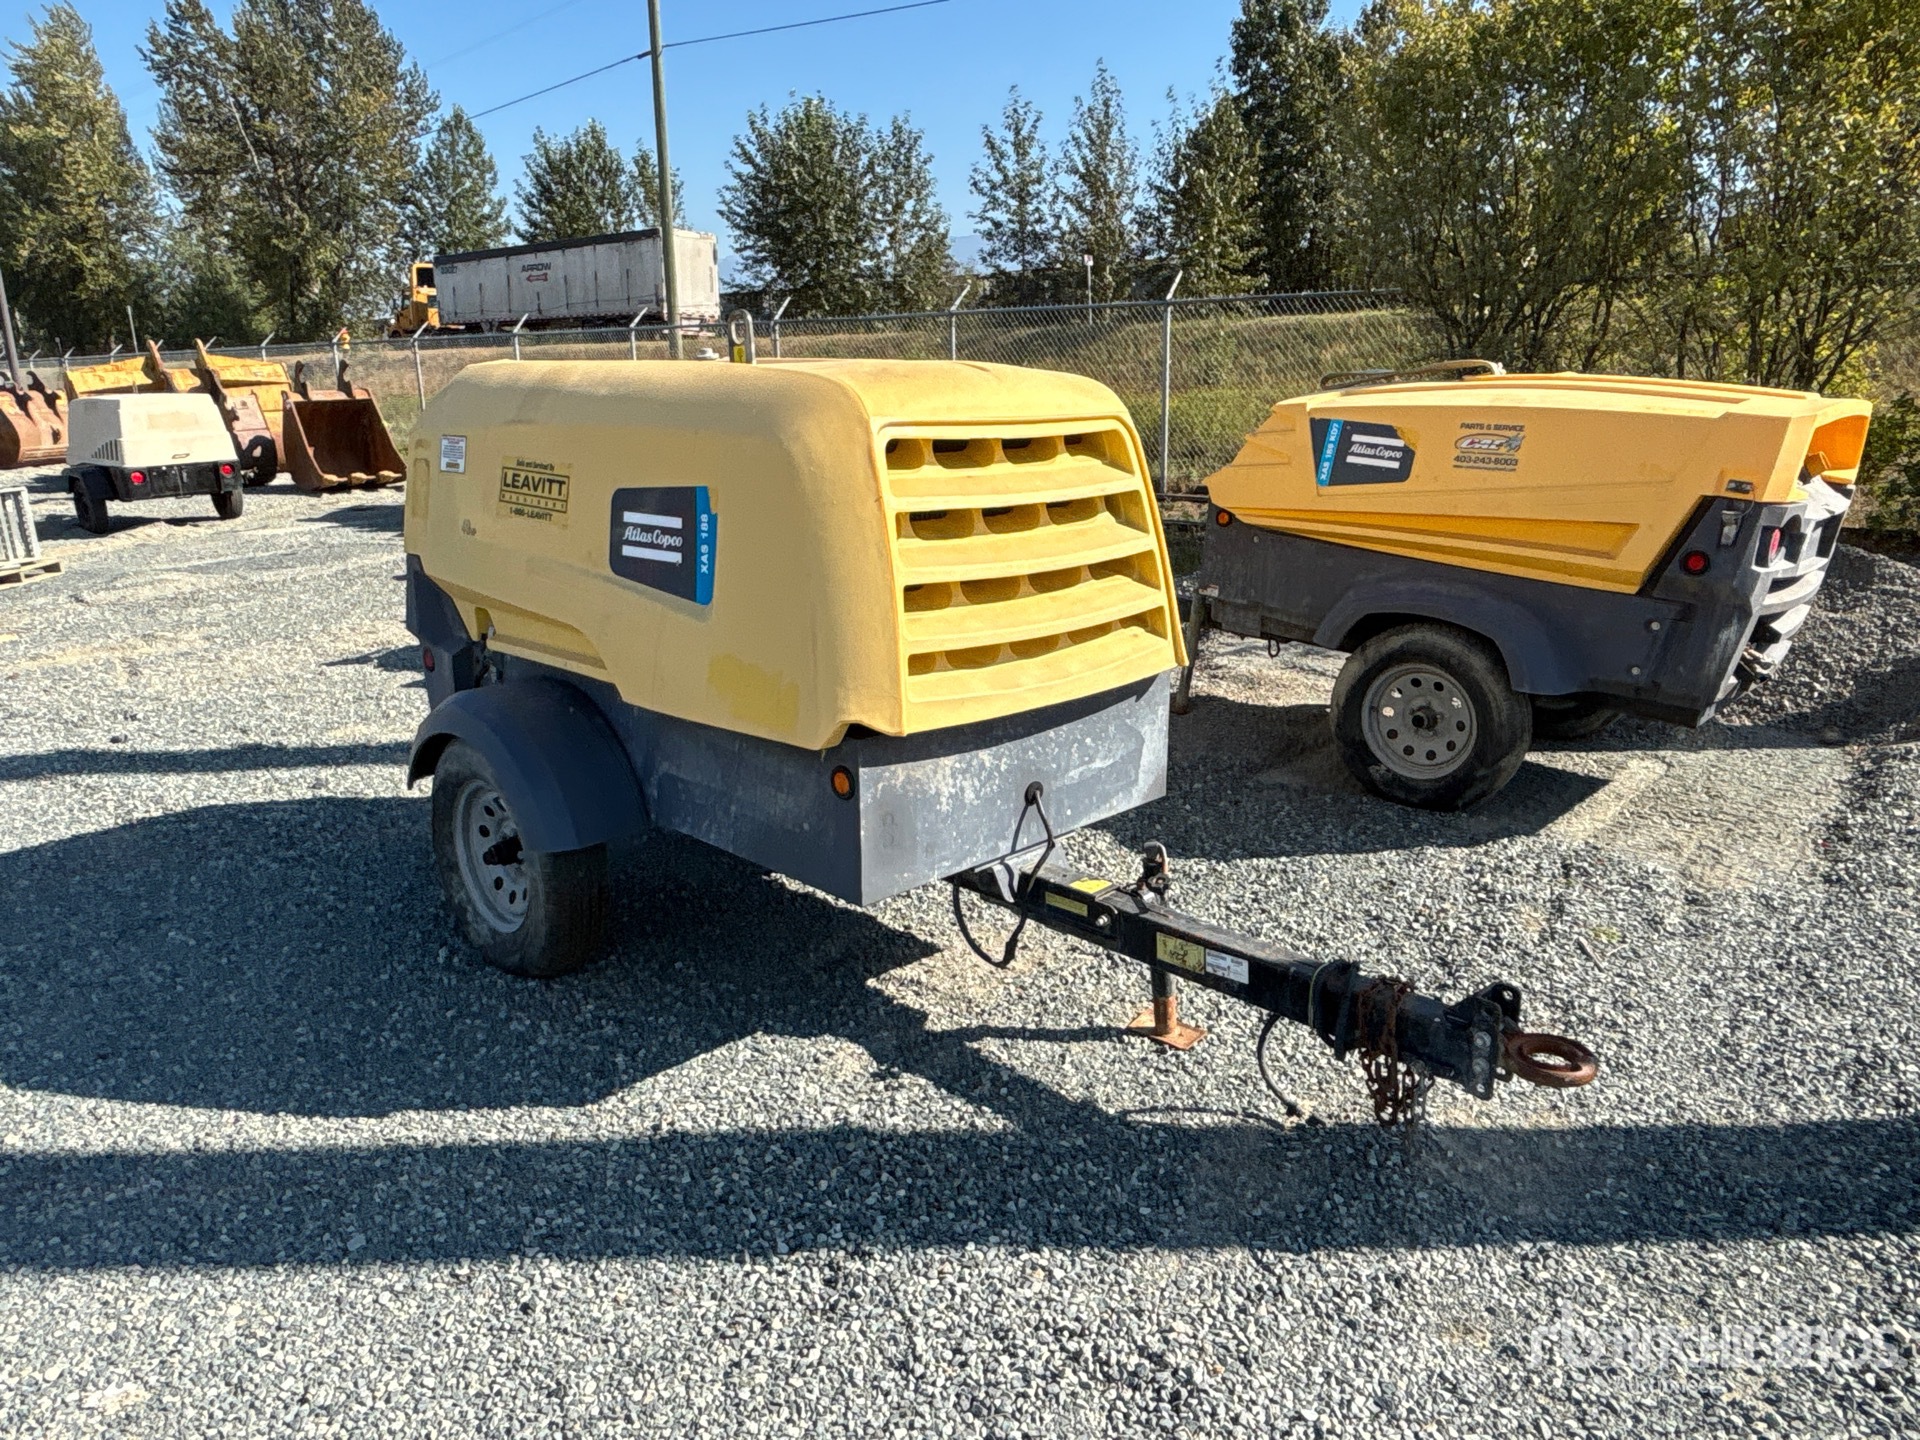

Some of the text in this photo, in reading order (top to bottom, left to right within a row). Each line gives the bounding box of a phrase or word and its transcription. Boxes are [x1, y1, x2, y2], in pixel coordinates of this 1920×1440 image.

[521, 262, 552, 273] ARROW
[1460, 422, 1485, 430] PARTS
[1493, 424, 1525, 432] SERVICE
[1348, 443, 1403, 459] Atlas Copco
[1320, 461, 1330, 480] XAS
[503, 471, 566, 497] LEAVITT
[622, 525, 683, 549] Atlas Copco
[700, 513, 709, 575] XAS 188
